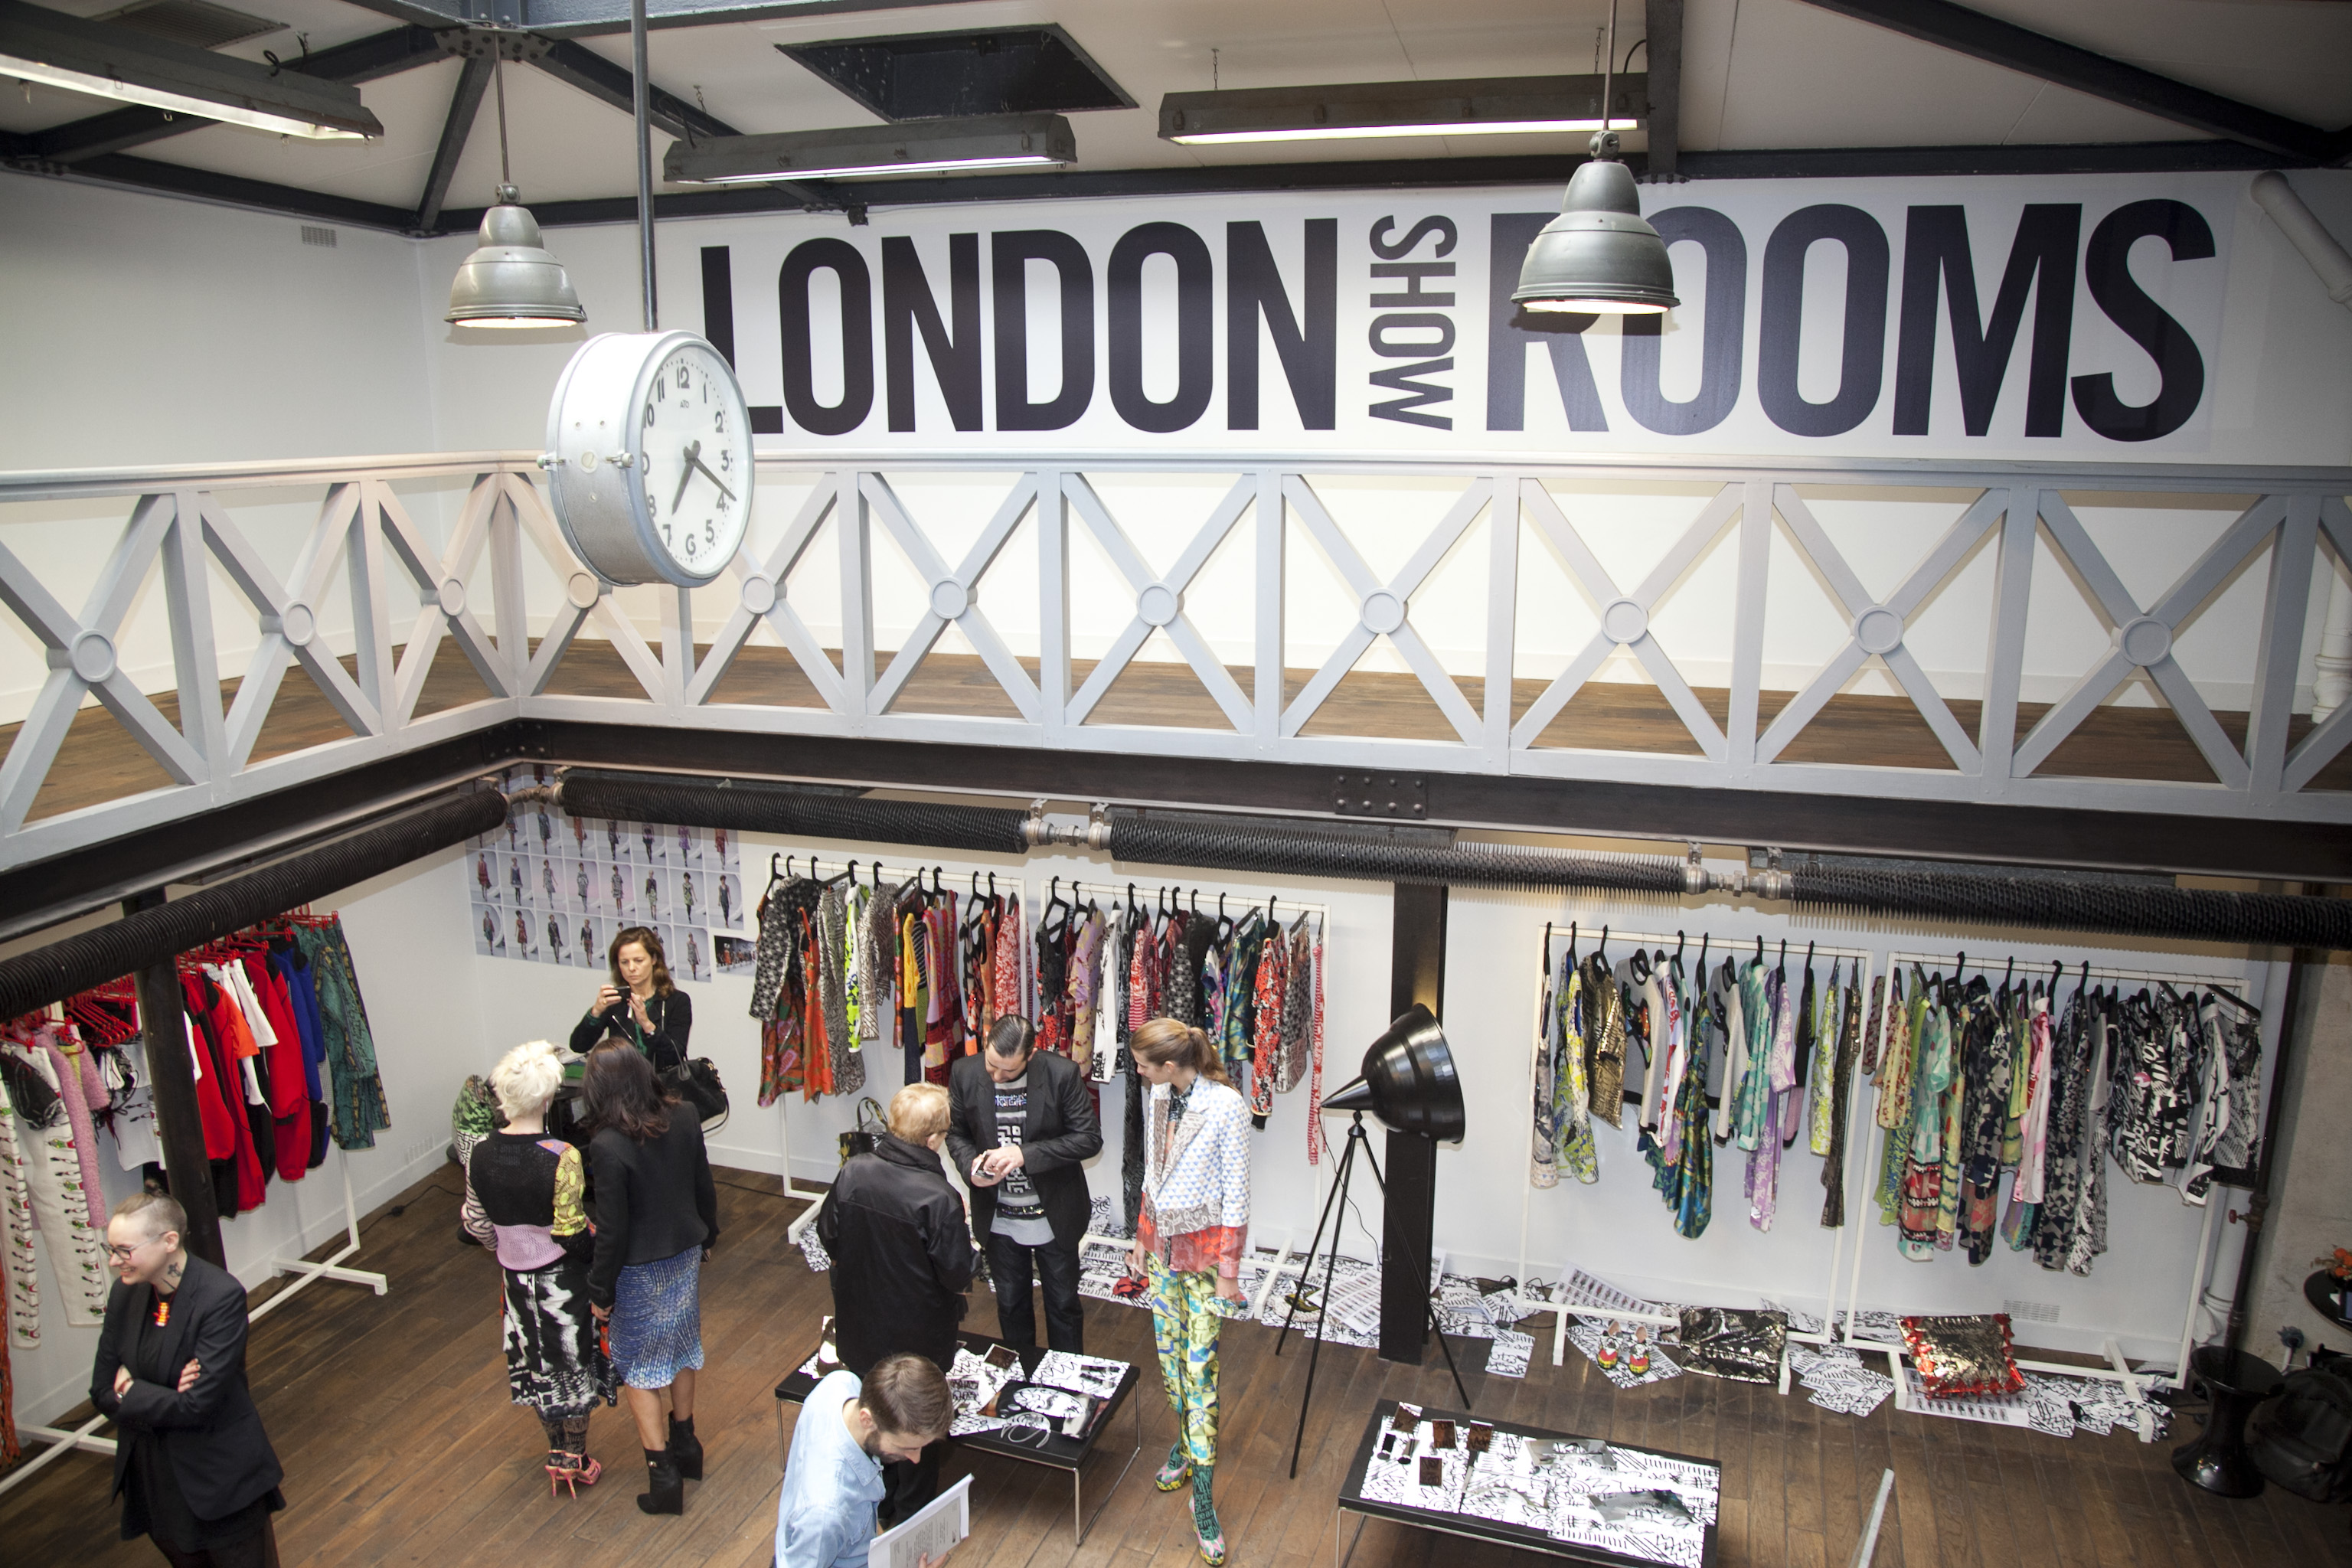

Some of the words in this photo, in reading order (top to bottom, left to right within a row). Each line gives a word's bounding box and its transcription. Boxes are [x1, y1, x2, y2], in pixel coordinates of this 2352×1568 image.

[701, 218, 1338, 436] LONDON
[1367, 214, 1458, 432] SHOW
[676, 366, 690, 389] 12
[657, 377, 665, 402] 11
[715, 411, 724, 433] 2
[721, 449, 729, 472] 3
[717, 491, 726, 513] 4
[662, 524, 671, 547] 7
[705, 519, 714, 543] 5
[686, 534, 696, 555] 6
